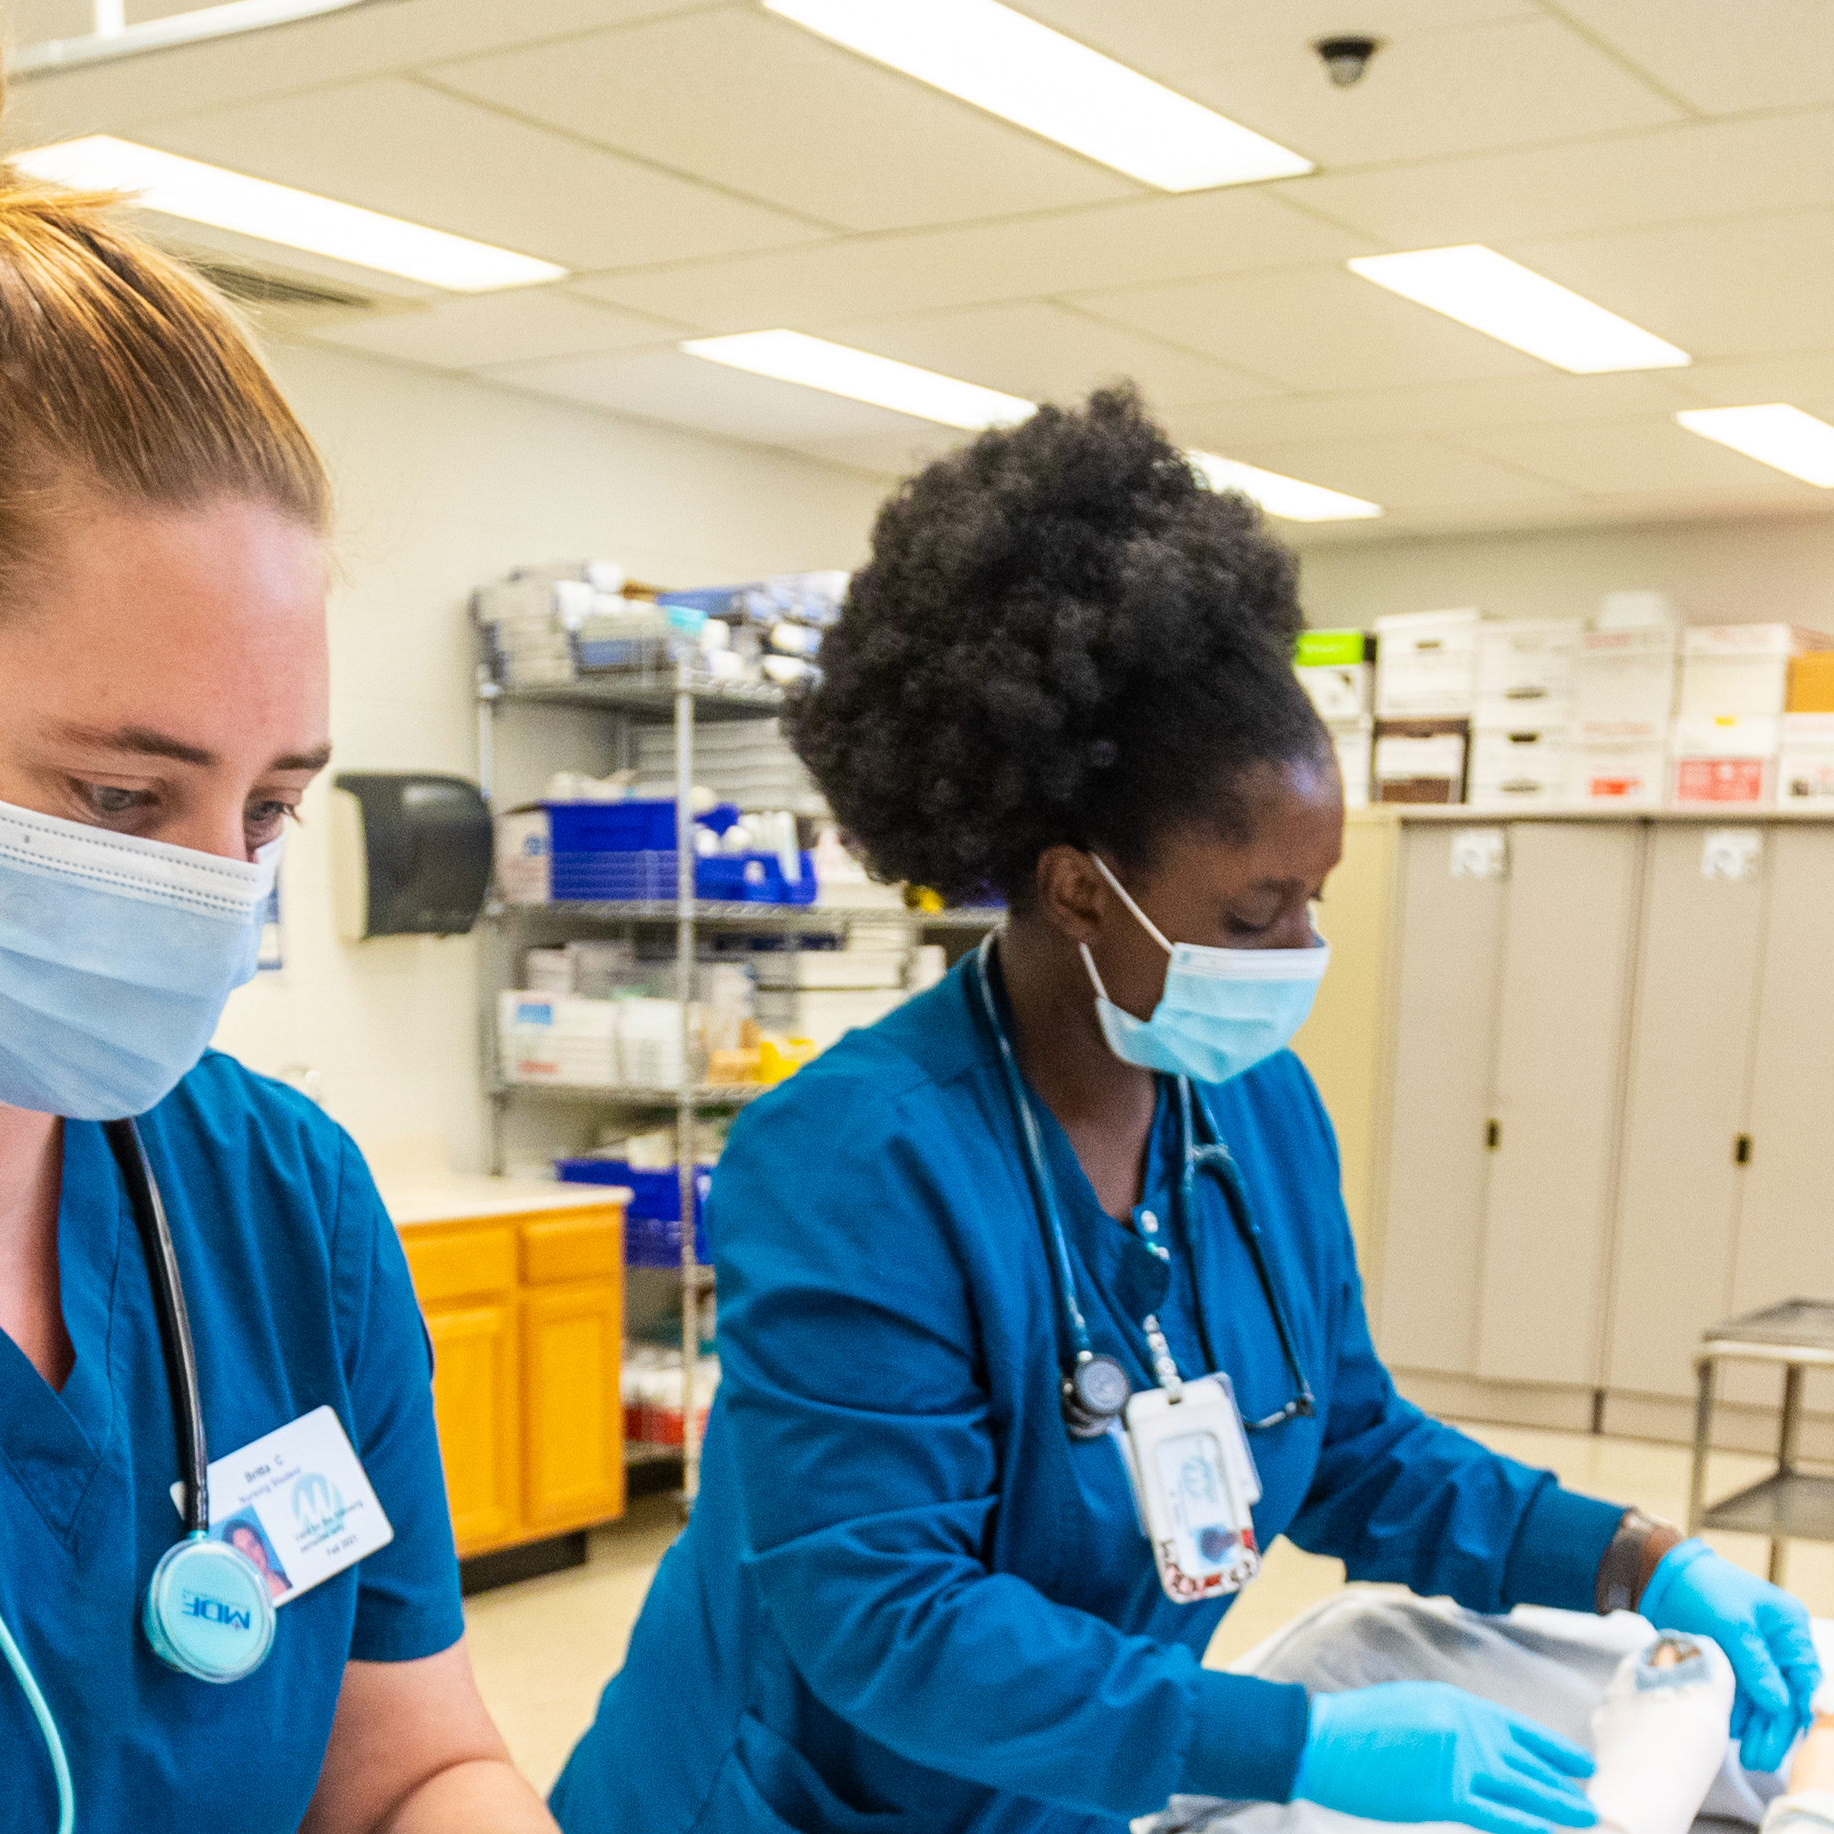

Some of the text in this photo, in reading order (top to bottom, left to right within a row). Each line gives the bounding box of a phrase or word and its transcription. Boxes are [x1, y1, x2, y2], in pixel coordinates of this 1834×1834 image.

[238, 1466, 301, 1504] Nursing Student
[244, 1454, 284, 1484] Britta C
[181, 1597, 250, 1629] MDF
